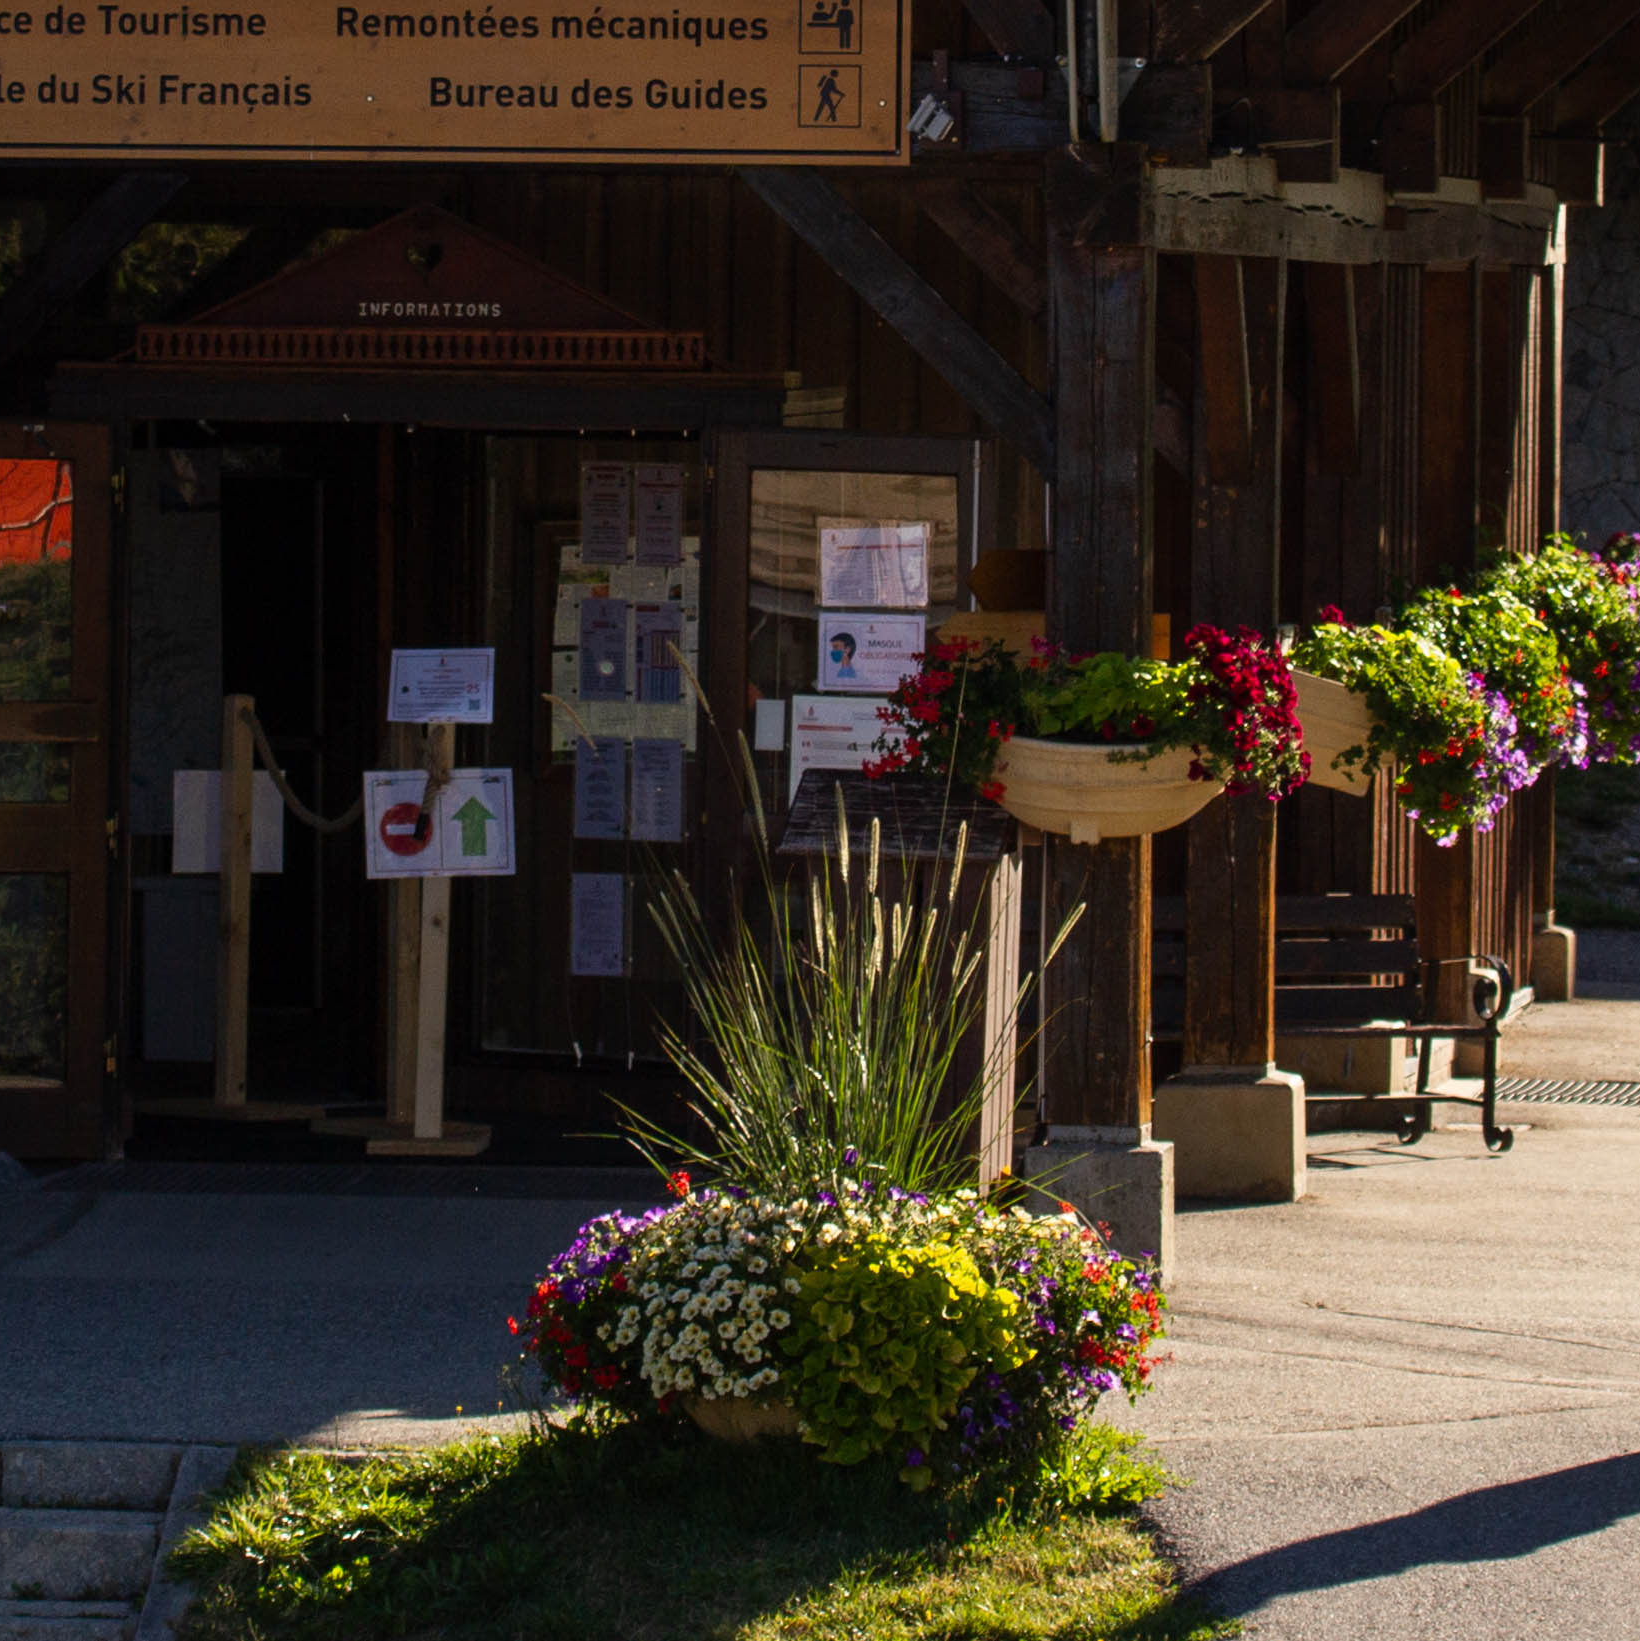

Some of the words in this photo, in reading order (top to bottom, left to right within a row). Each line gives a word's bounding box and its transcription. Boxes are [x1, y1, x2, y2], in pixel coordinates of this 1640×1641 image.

[44, 5, 86, 35] de
[98, 5, 267, 36] Tourisme
[336, 6, 539, 38] Remontées
[551, 6, 769, 47] mécaniques
[37, 74, 80, 104] du
[92, 74, 146, 105] Ski
[159, 75, 312, 113] Français
[430, 77, 558, 108] Bureau
[570, 79, 632, 109] des
[644, 79, 768, 110] Guides
[358, 302, 503, 318] INFORMATIONS
